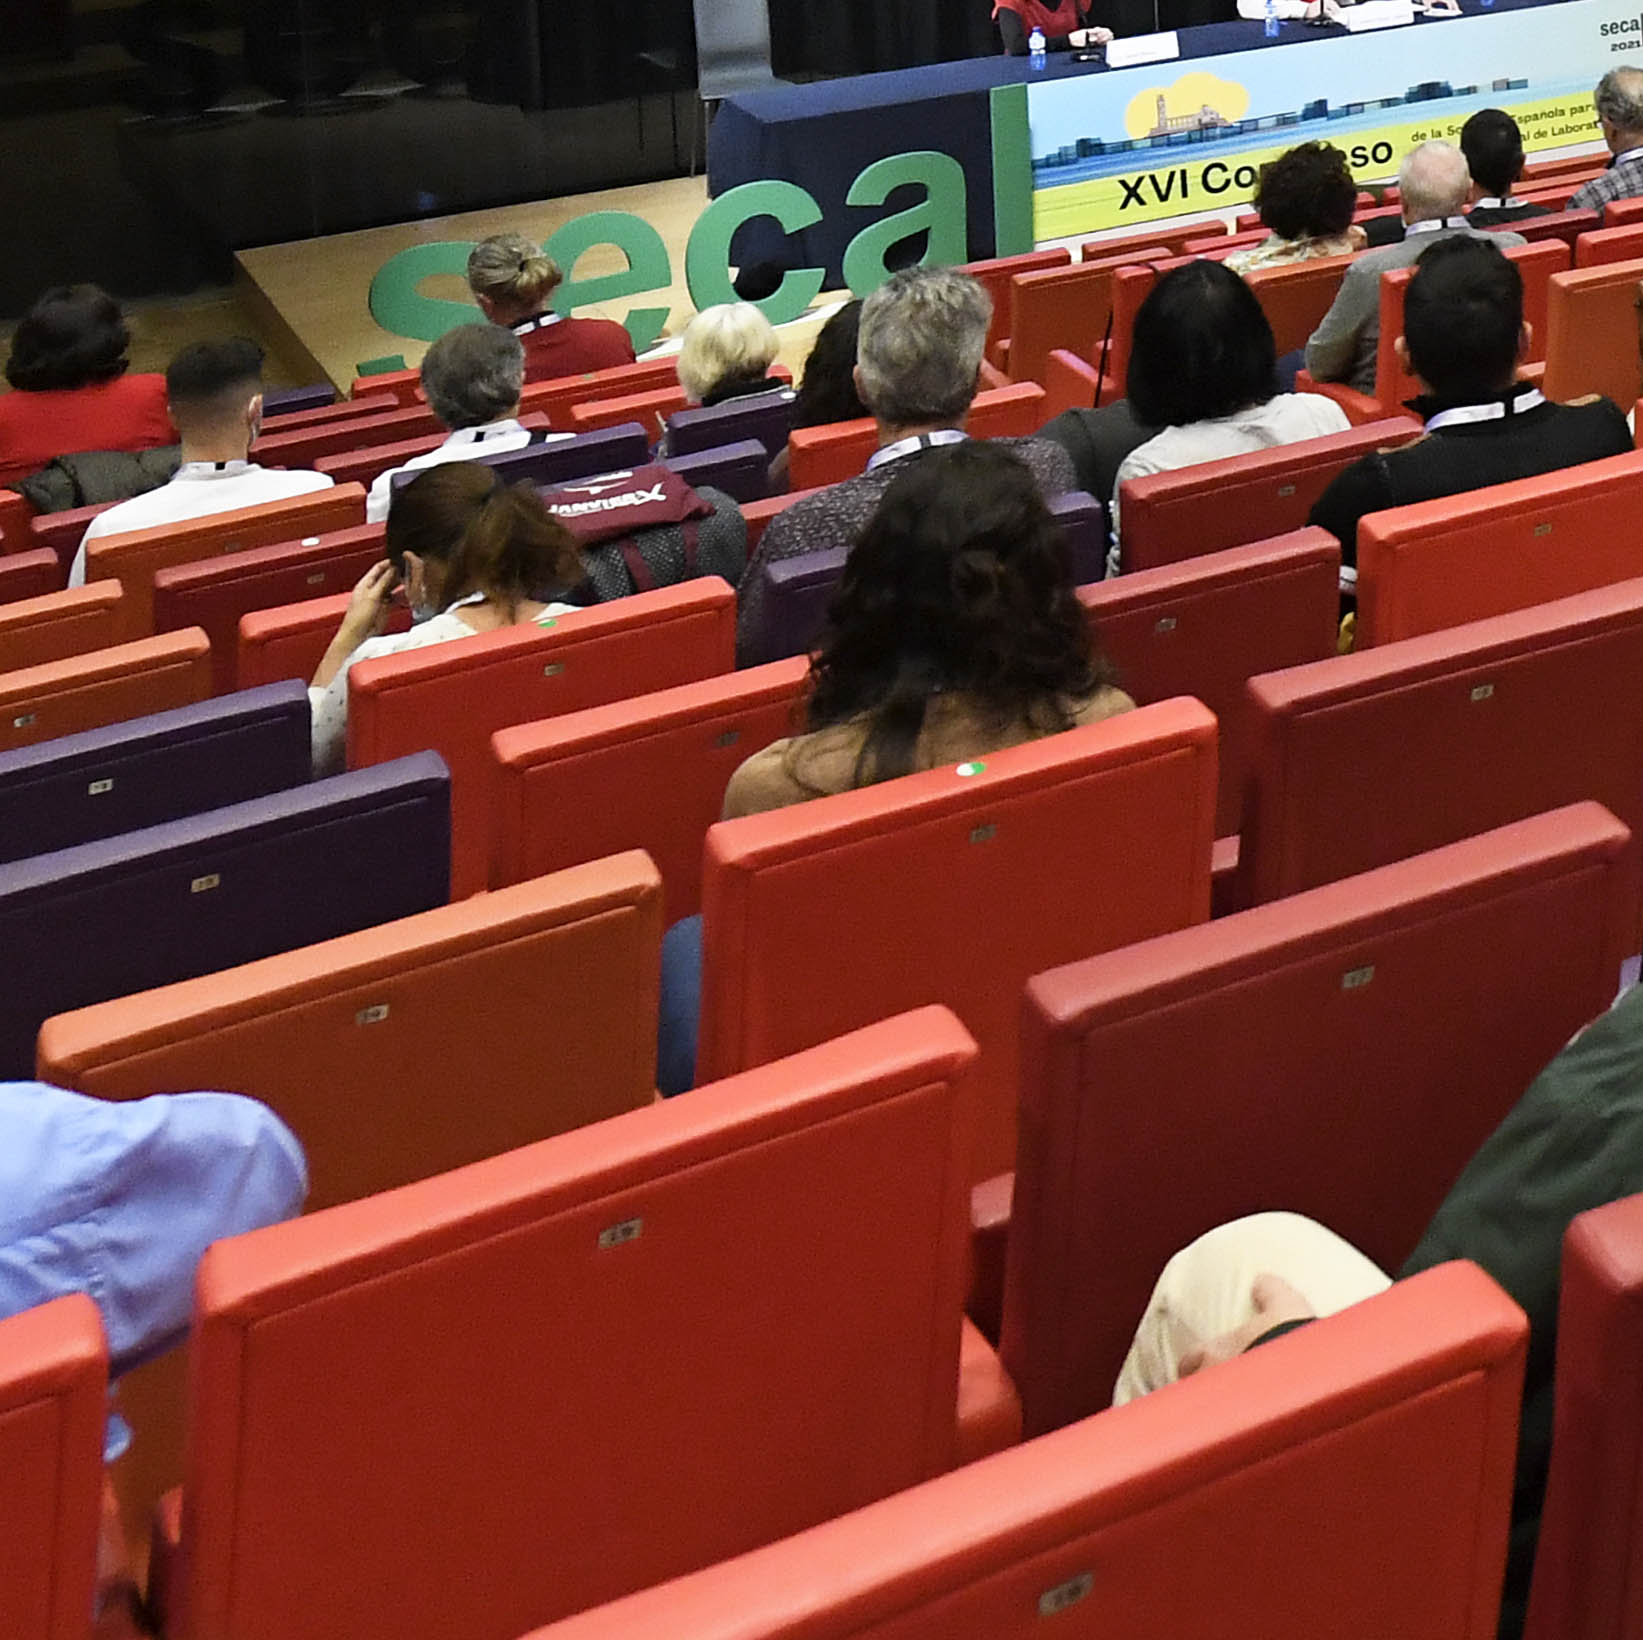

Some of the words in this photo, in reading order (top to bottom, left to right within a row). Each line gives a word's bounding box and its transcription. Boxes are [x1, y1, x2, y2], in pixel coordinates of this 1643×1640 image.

[1611, 40, 1641, 52] 2021
[1411, 131, 1427, 142] de
[1431, 129, 1442, 138] la
[1533, 129, 1548, 140] de
[1119, 168, 1190, 210] XVI
[1201, 142, 1393, 194] Coso
